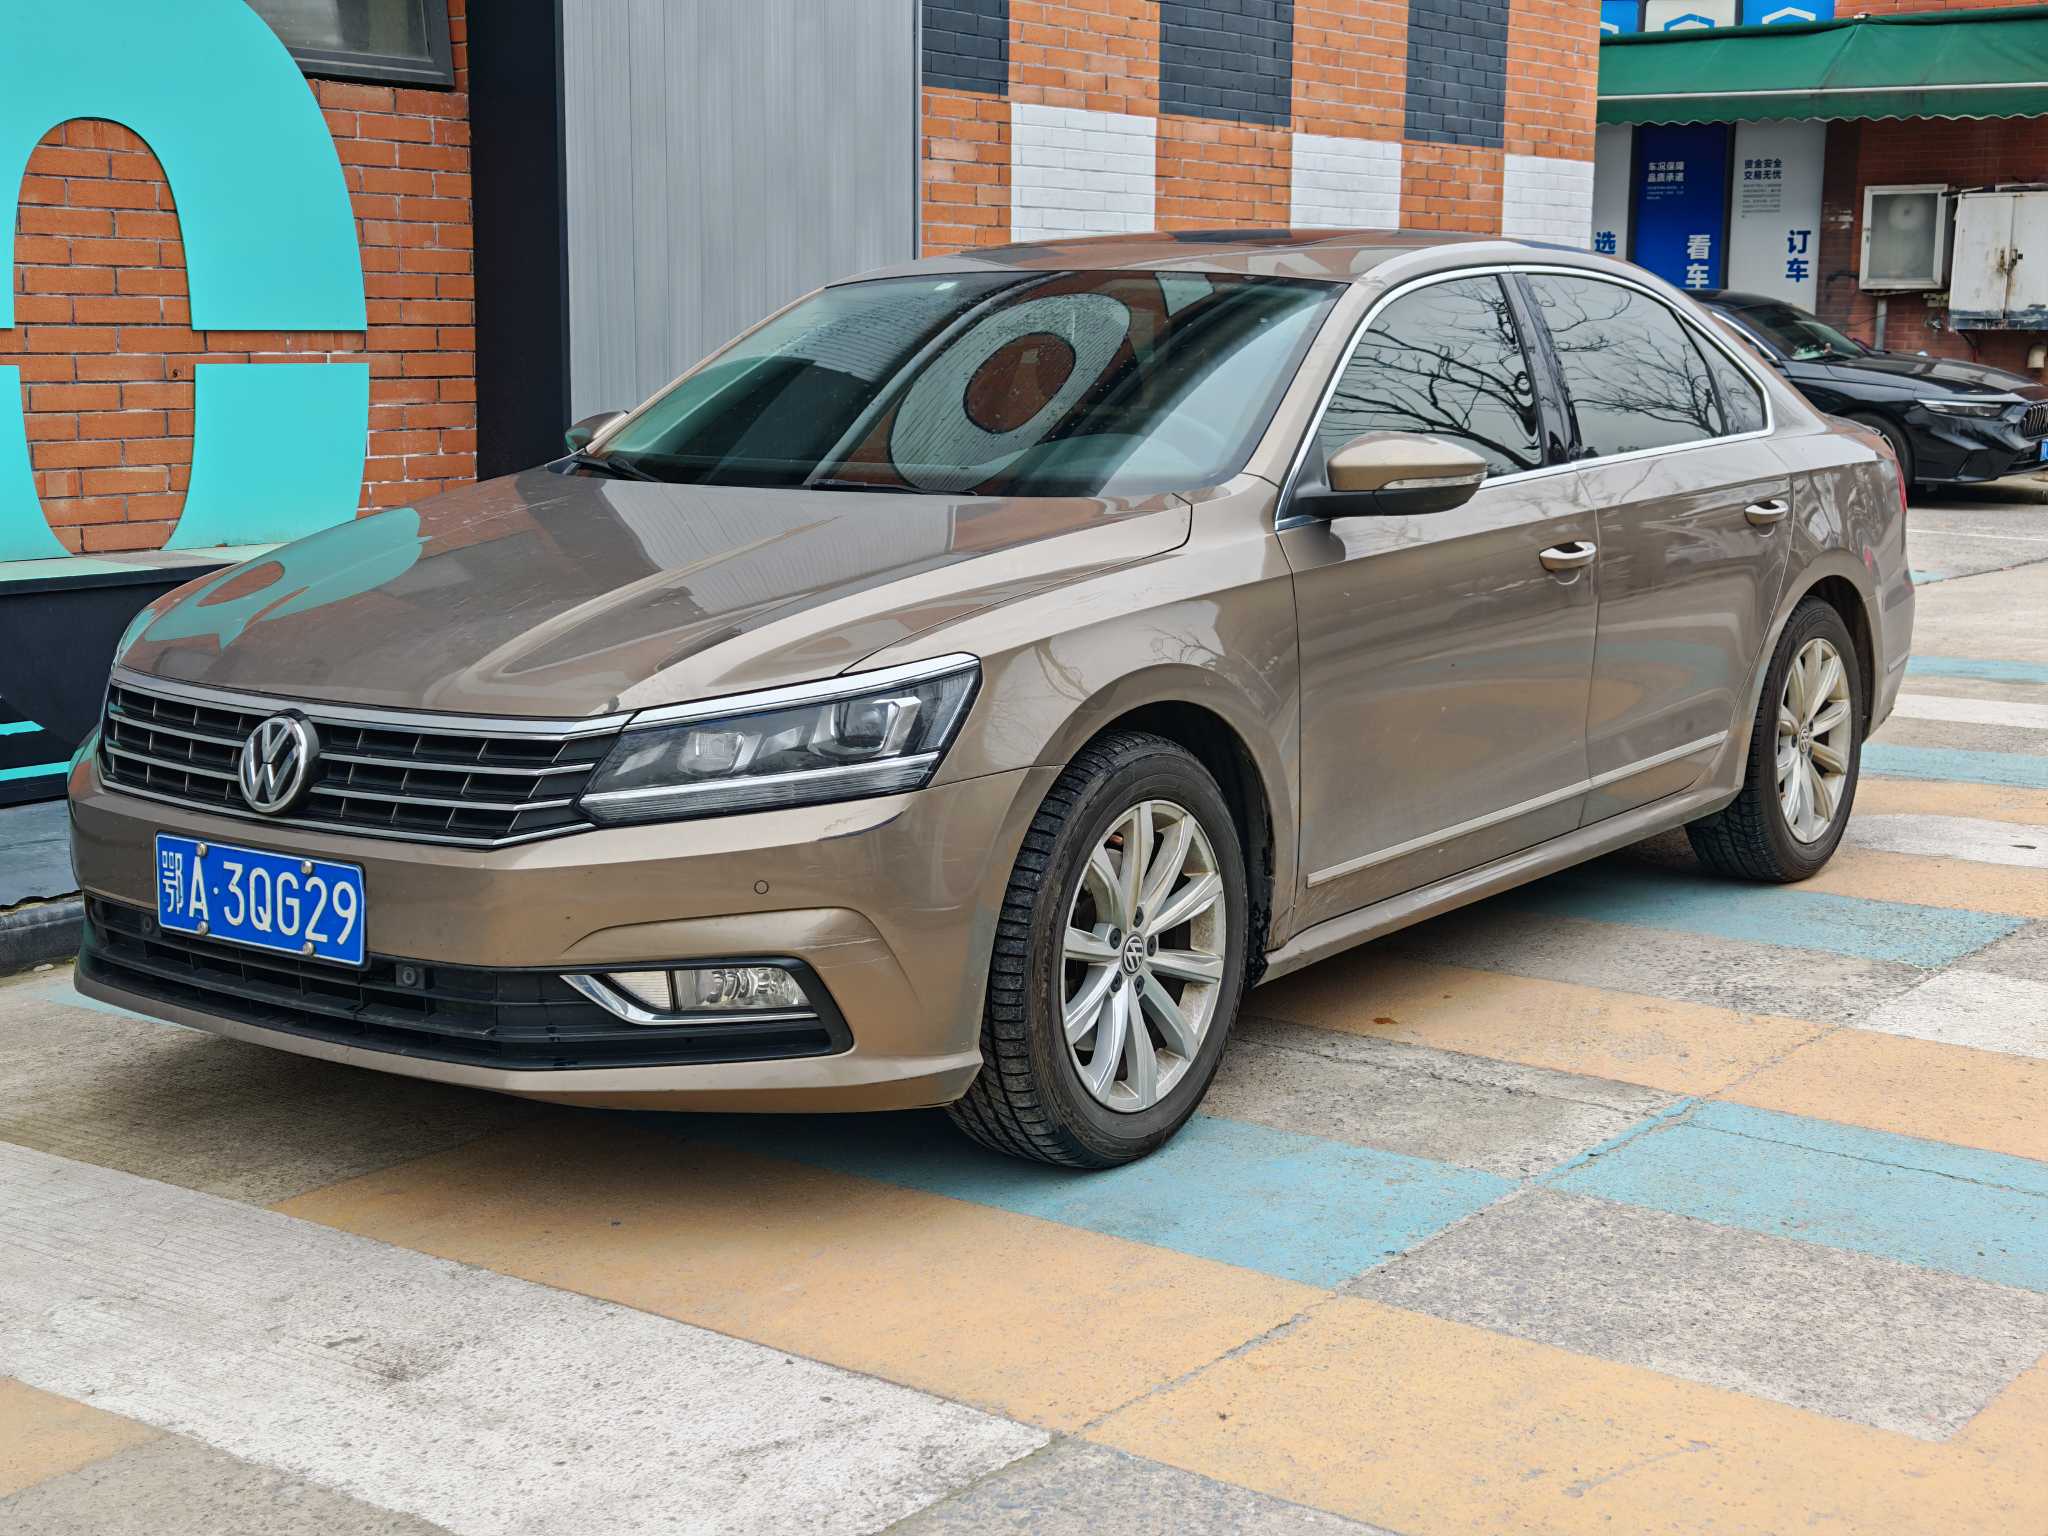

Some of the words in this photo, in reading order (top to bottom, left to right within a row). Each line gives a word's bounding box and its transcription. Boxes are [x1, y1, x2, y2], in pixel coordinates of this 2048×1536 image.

[1743, 169, 1782, 181] 交易无忧
[1685, 234, 1711, 289] 看车
[1785, 229, 1811, 282] 订车
